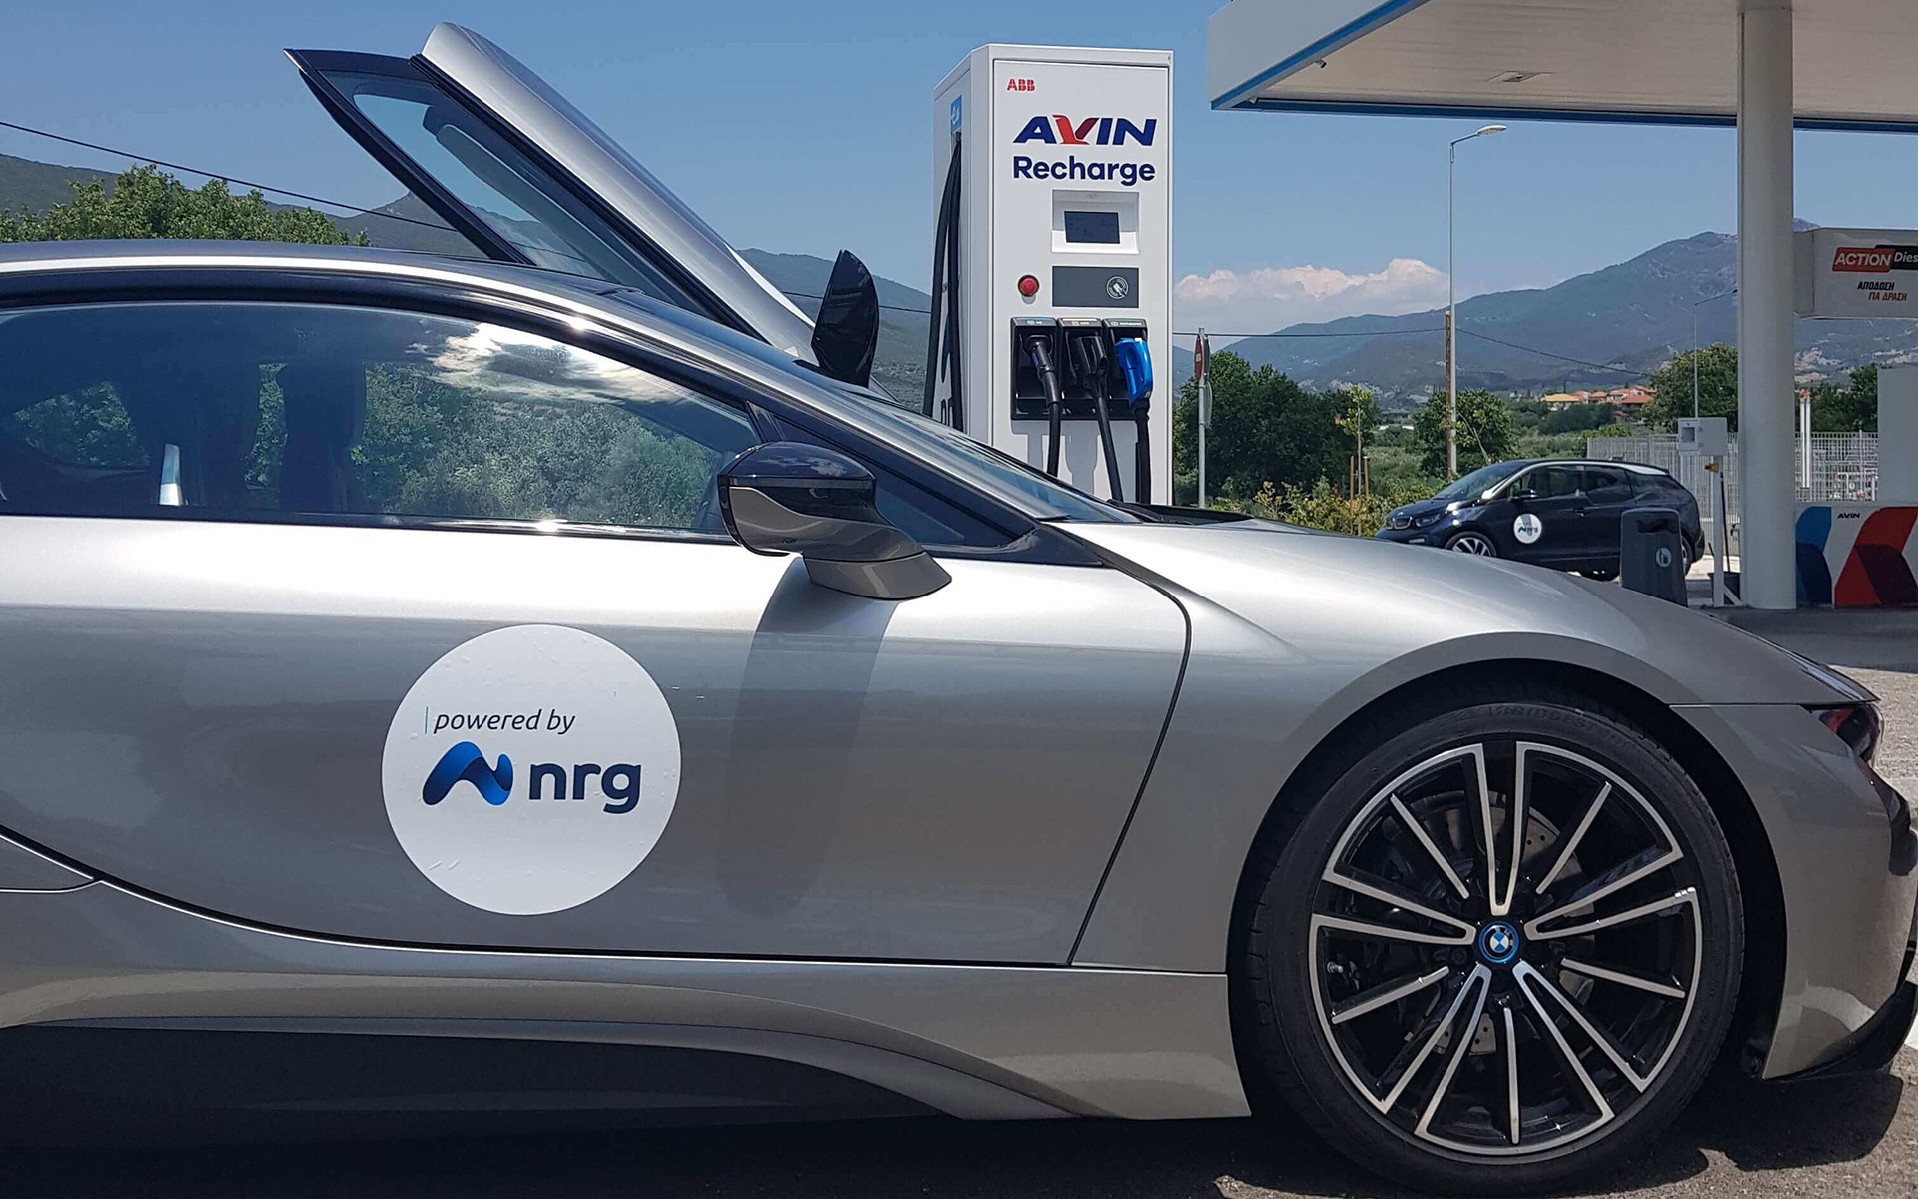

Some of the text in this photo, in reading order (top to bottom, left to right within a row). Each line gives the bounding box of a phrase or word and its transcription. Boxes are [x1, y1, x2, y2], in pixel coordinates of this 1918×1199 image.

[1007, 79, 1035, 91] ABB
[1012, 114, 1157, 146] AVIN
[1013, 156, 1156, 186] Recharge
[1835, 253, 1892, 266] ACTION
[1857, 281, 1895, 290] ΑΠΟΔΟΣΗ
[1869, 292, 1908, 301] ΓΙΑ ΔΡΑΣΗ
[434, 709, 575, 734] powered by
[529, 763, 642, 814] nrg
